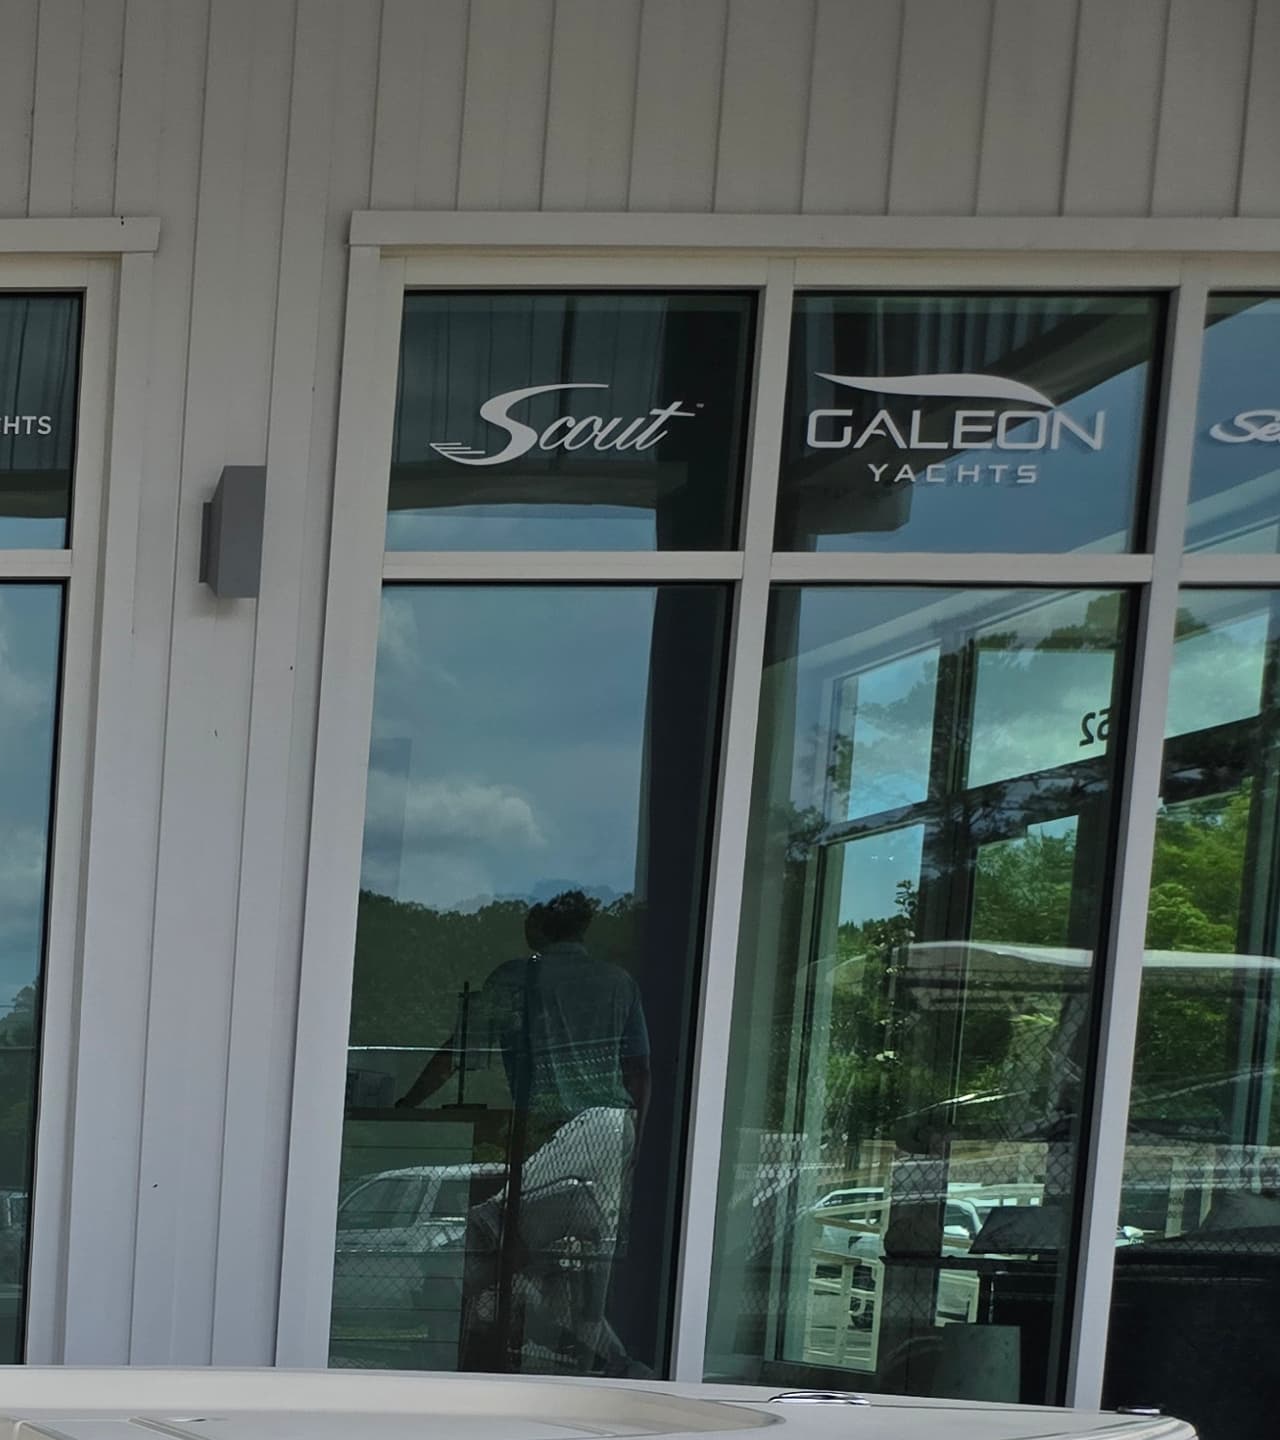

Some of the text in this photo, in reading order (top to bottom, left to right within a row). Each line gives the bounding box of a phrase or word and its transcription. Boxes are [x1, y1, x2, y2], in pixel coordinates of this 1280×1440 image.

[429, 383, 696, 466] Scout
[806, 408, 1106, 451] GALEON
[867, 463, 1038, 484] YACHTS
